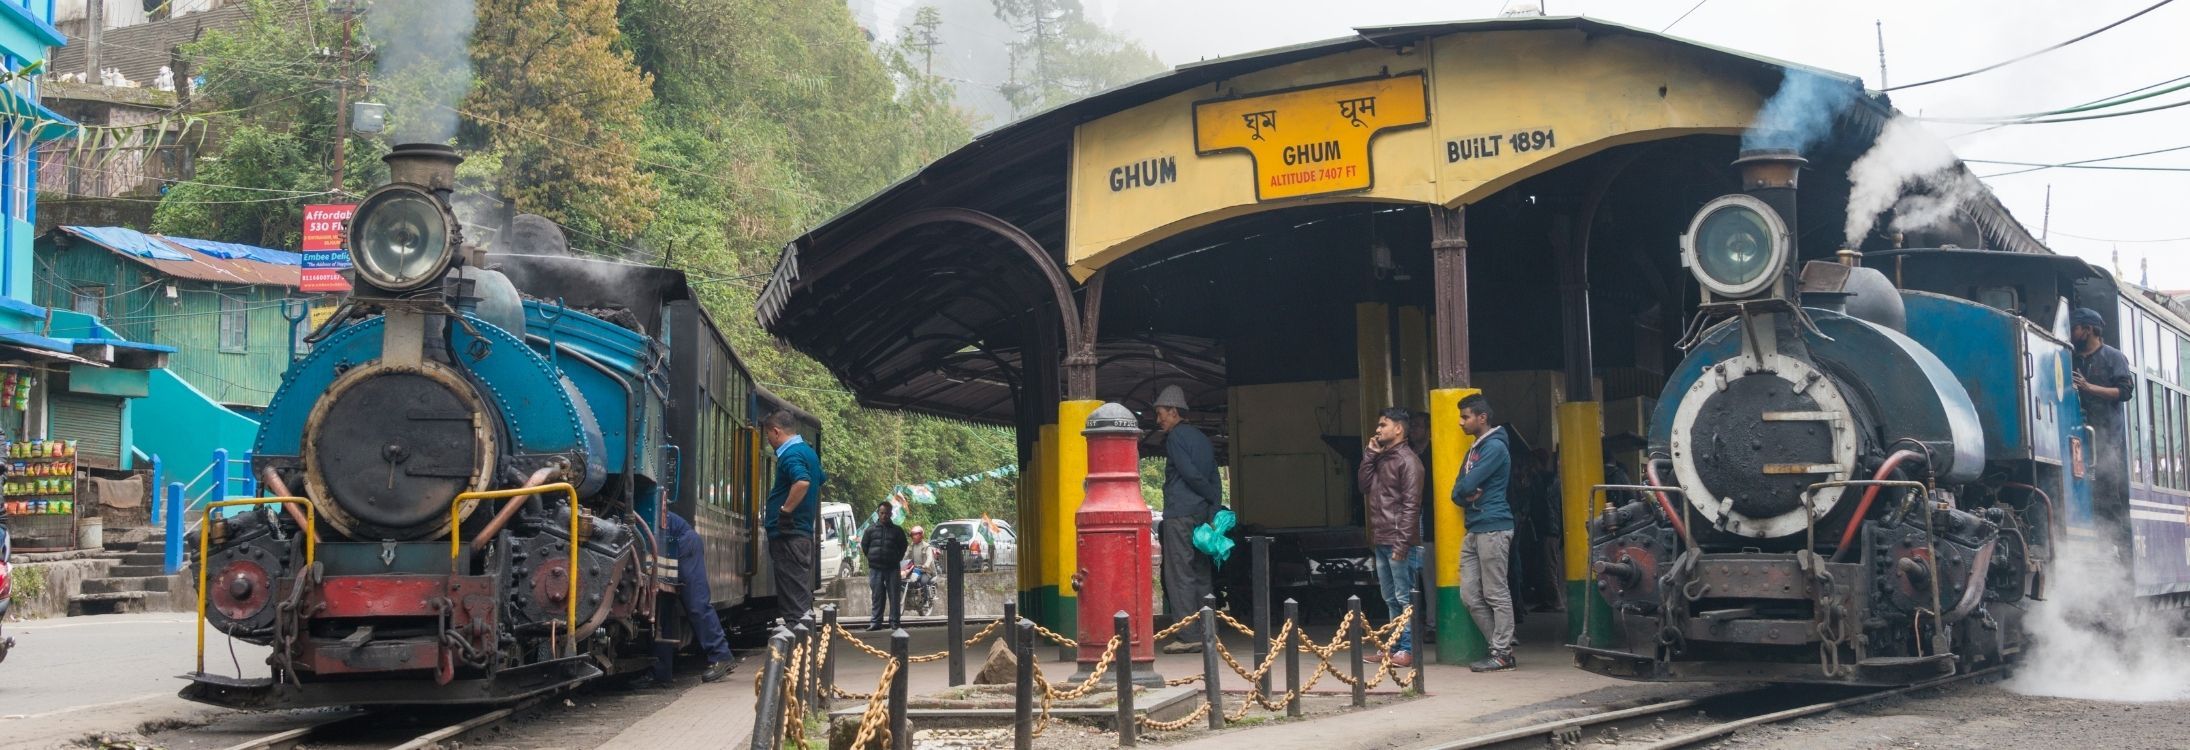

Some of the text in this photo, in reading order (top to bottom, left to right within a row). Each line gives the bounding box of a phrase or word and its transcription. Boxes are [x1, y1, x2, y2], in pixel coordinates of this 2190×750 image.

[1337, 96, 1376, 128] घूम
[1283, 140, 1341, 165] GHUM
[1509, 129, 1555, 153] 1891
[1109, 156, 1176, 192] GHUM
[1271, 165, 1356, 187] ALTITUDE 7407 FT
[306, 211, 352, 220] Affordab
[310, 222, 329, 231] 530
[303, 252, 350, 262] Embee Delig
